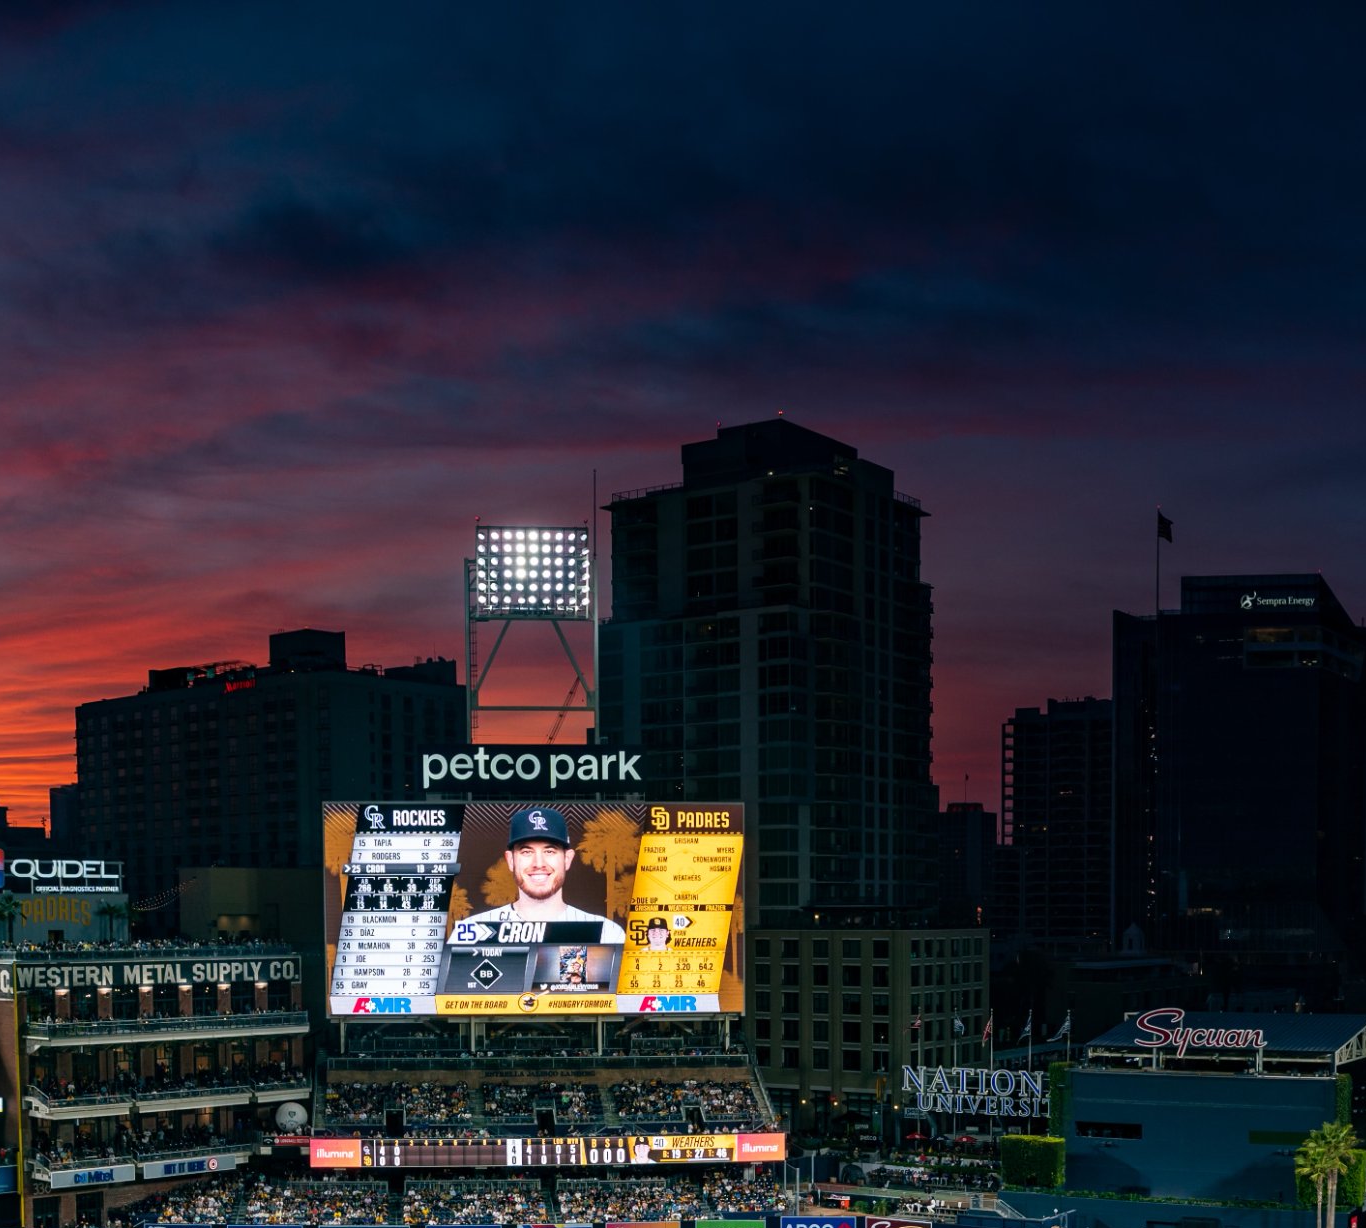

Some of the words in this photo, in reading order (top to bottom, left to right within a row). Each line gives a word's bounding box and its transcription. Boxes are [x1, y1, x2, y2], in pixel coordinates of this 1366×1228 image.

[1257, 597, 1286, 607] Sempra
[1288, 596, 1315, 606] Energy
[423, 747, 541, 789] petco
[550, 751, 642, 789] park
[393, 810, 446, 826] ROCKIES
[677, 812, 730, 828] PADRES
[10, 859, 119, 880] QUIDEL
[366, 865, 386, 873] CRON
[431, 865, 447, 873] .244
[21, 897, 92, 927] PADRES
[457, 923, 476, 941] 25
[498, 922, 547, 943] CRON
[674, 938, 717, 947] WEATHERS
[482, 949, 503, 957] TODAY
[16, 966, 113, 988] WESTERN
[123, 964, 186, 984] METAL
[192, 961, 263, 983] SUPPLY
[270, 960, 299, 981] CO.
[480, 970, 493, 978] BB
[445, 1001, 456, 1009] GET
[548, 1000, 613, 1008] #HUNGRYFORMORE
[1134, 1008, 1267, 1058] Sycuan
[654, 1139, 664, 1147] 40
[672, 1136, 715, 1148] WEATHERS
[742, 1143, 778, 1152] illumina
[316, 1148, 355, 1160] illumina
[671, 1150, 681, 1159] 19
[694, 1150, 703, 1159] 27
[716, 1149, 727, 1158] 46
[187, 1160, 206, 1173] HERE
[88, 1169, 114, 1183] Mitel
